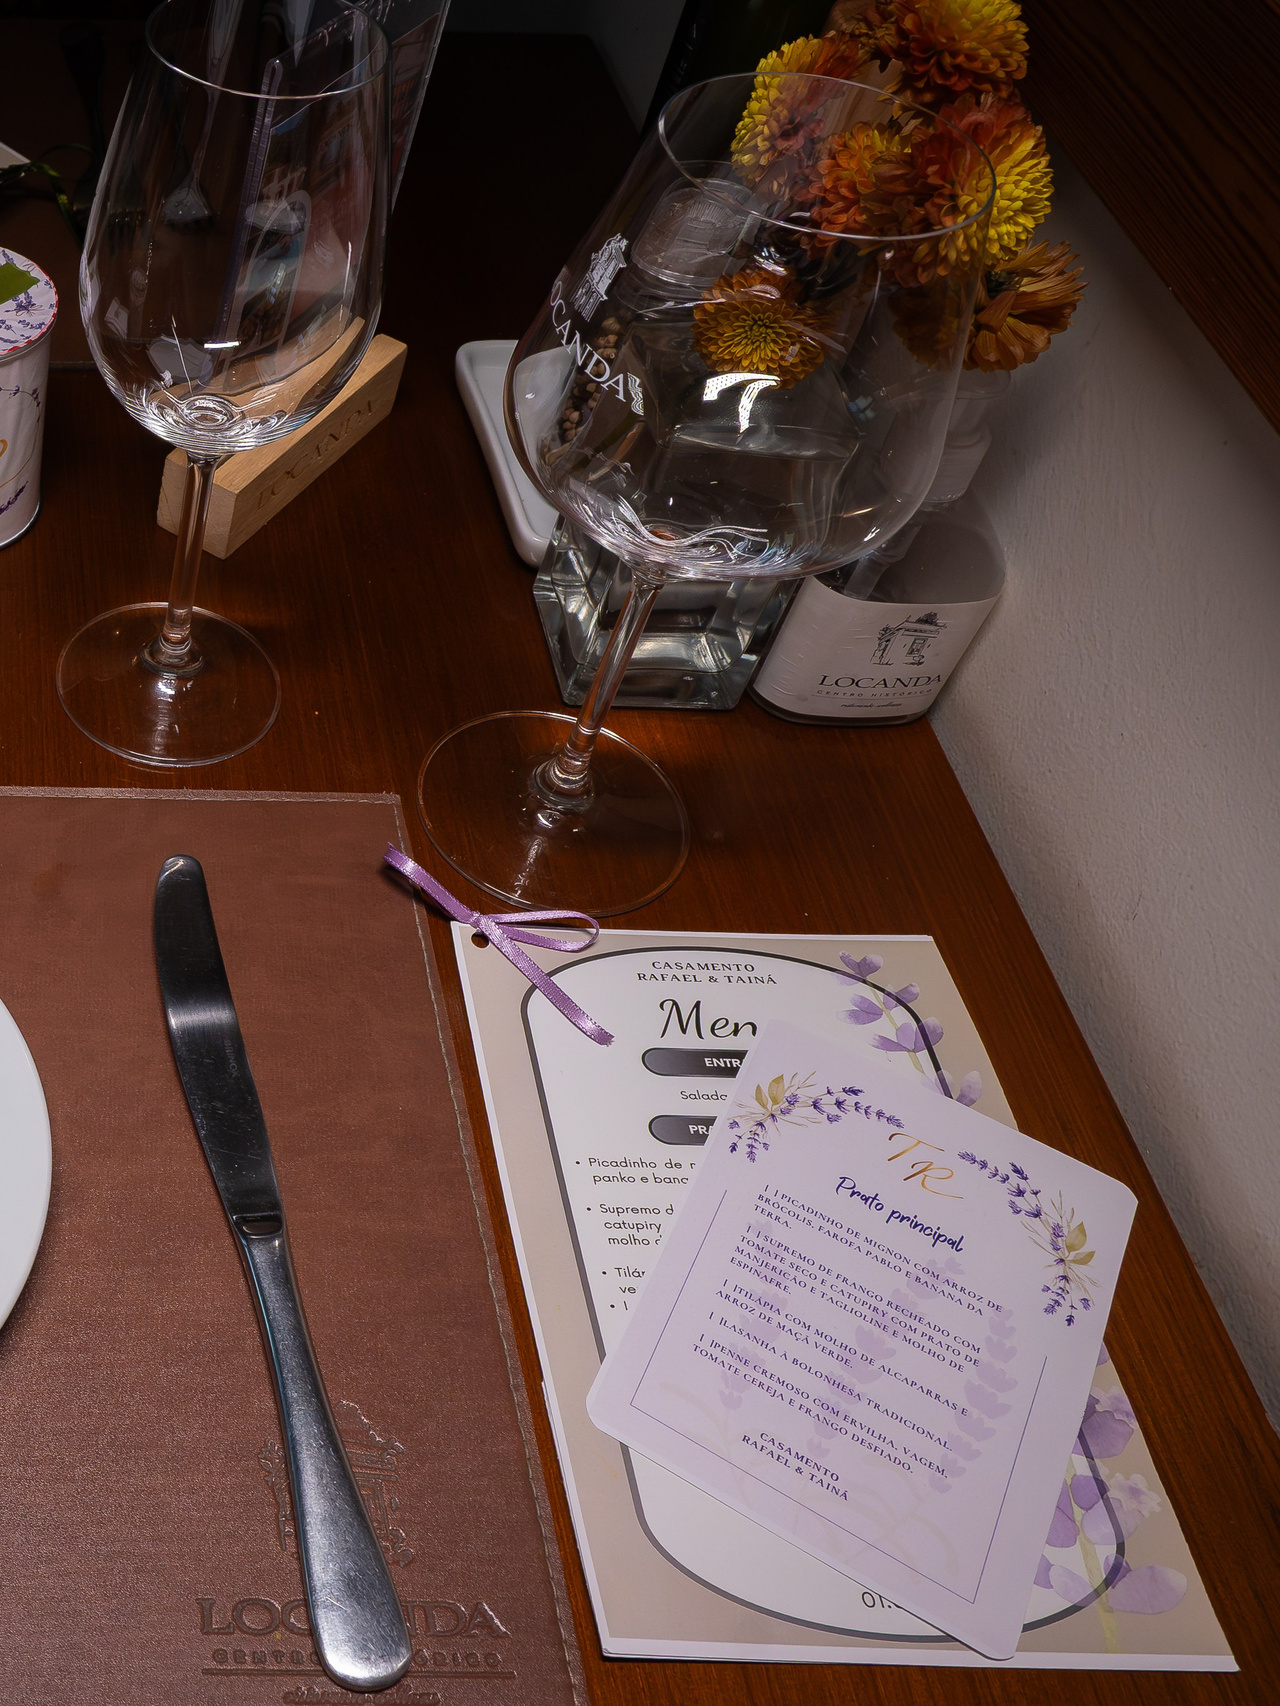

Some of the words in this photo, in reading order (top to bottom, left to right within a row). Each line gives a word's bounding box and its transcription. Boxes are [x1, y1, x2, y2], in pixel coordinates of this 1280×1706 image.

[549, 280, 627, 403] OCANDA
[816, 689, 864, 698] CENTRO
[818, 673, 942, 689] LOCANDA
[637, 972, 703, 983] RAFAEL
[708, 974, 719, 983] &
[723, 973, 778, 985] TAINÁ
[651, 960, 755, 973] CASAMENTO
[658, 998, 758, 1040] Men
[703, 1056, 745, 1069] ENTR
[587, 1156, 658, 1170] Picadinho
[664, 1157, 683, 1170] de
[592, 1171, 636, 1186] panko
[640, 1175, 649, 1184] e
[599, 1203, 662, 1218] Supremo
[603, 1219, 663, 1234] catupiry
[835, 1176, 885, 1212] Prato
[885, 1208, 965, 1253] principal
[607, 1233, 651, 1246] molho
[780, 1193, 843, 1229] PICADINHO
[846, 1227, 860, 1239] DE
[863, 1236, 910, 1264] MIGNON
[913, 1262, 939, 1280] COM
[942, 1278, 983, 1303] ARROZ
[986, 1299, 1002, 1312] DE
[762, 1234, 815, 1266] SUPREMO
[818, 1263, 832, 1276] DE
[835, 1273, 883, 1302] FRANGO
[886, 1299, 949, 1337] RECHEADO
[953, 1335, 980, 1353] COM
[817, 1225, 861, 1253] FAROFA
[865, 1249, 901, 1272] PABLO
[914, 1275, 962, 1305] BANANA
[966, 1302, 982, 1315] DA
[715, 1290, 755, 1315] ARROZ
[758, 1311, 773, 1324] DE
[775, 1321, 809, 1344] MAÇÃ
[734, 1245, 806, 1288] MANJERICÃO
[820, 1290, 889, 1332] TAGLIOLINE
[901, 1334, 945, 1361] MOLHO
[948, 1359, 964, 1372] DE
[740, 1234, 786, 1264] TOMATE
[788, 1261, 817, 1280] SECO
[829, 1283, 888, 1317] CATUPIRY
[890, 1316, 917, 1334] COM
[920, 1331, 960, 1356] PRATO
[964, 1354, 979, 1367] DE
[784, 1313, 811, 1331] COM
[813, 1328, 857, 1355] MOLHO
[860, 1353, 875, 1366] DE
[877, 1364, 958, 1410] ALCAPARRAS
[791, 1357, 861, 1401] BOLONHESA
[693, 1343, 740, 1375] TOMATE
[743, 1373, 784, 1401] CEREJA
[798, 1403, 847, 1435] FRANGO
[753, 1364, 809, 1399] CREMOSO
[812, 1397, 839, 1417] COM
[741, 1434, 790, 1468] RAFAEL
[808, 1472, 847, 1501] TAINÁ
[759, 1431, 840, 1482] CASAMENTO
[195, 1597, 514, 1639] LOCDA
